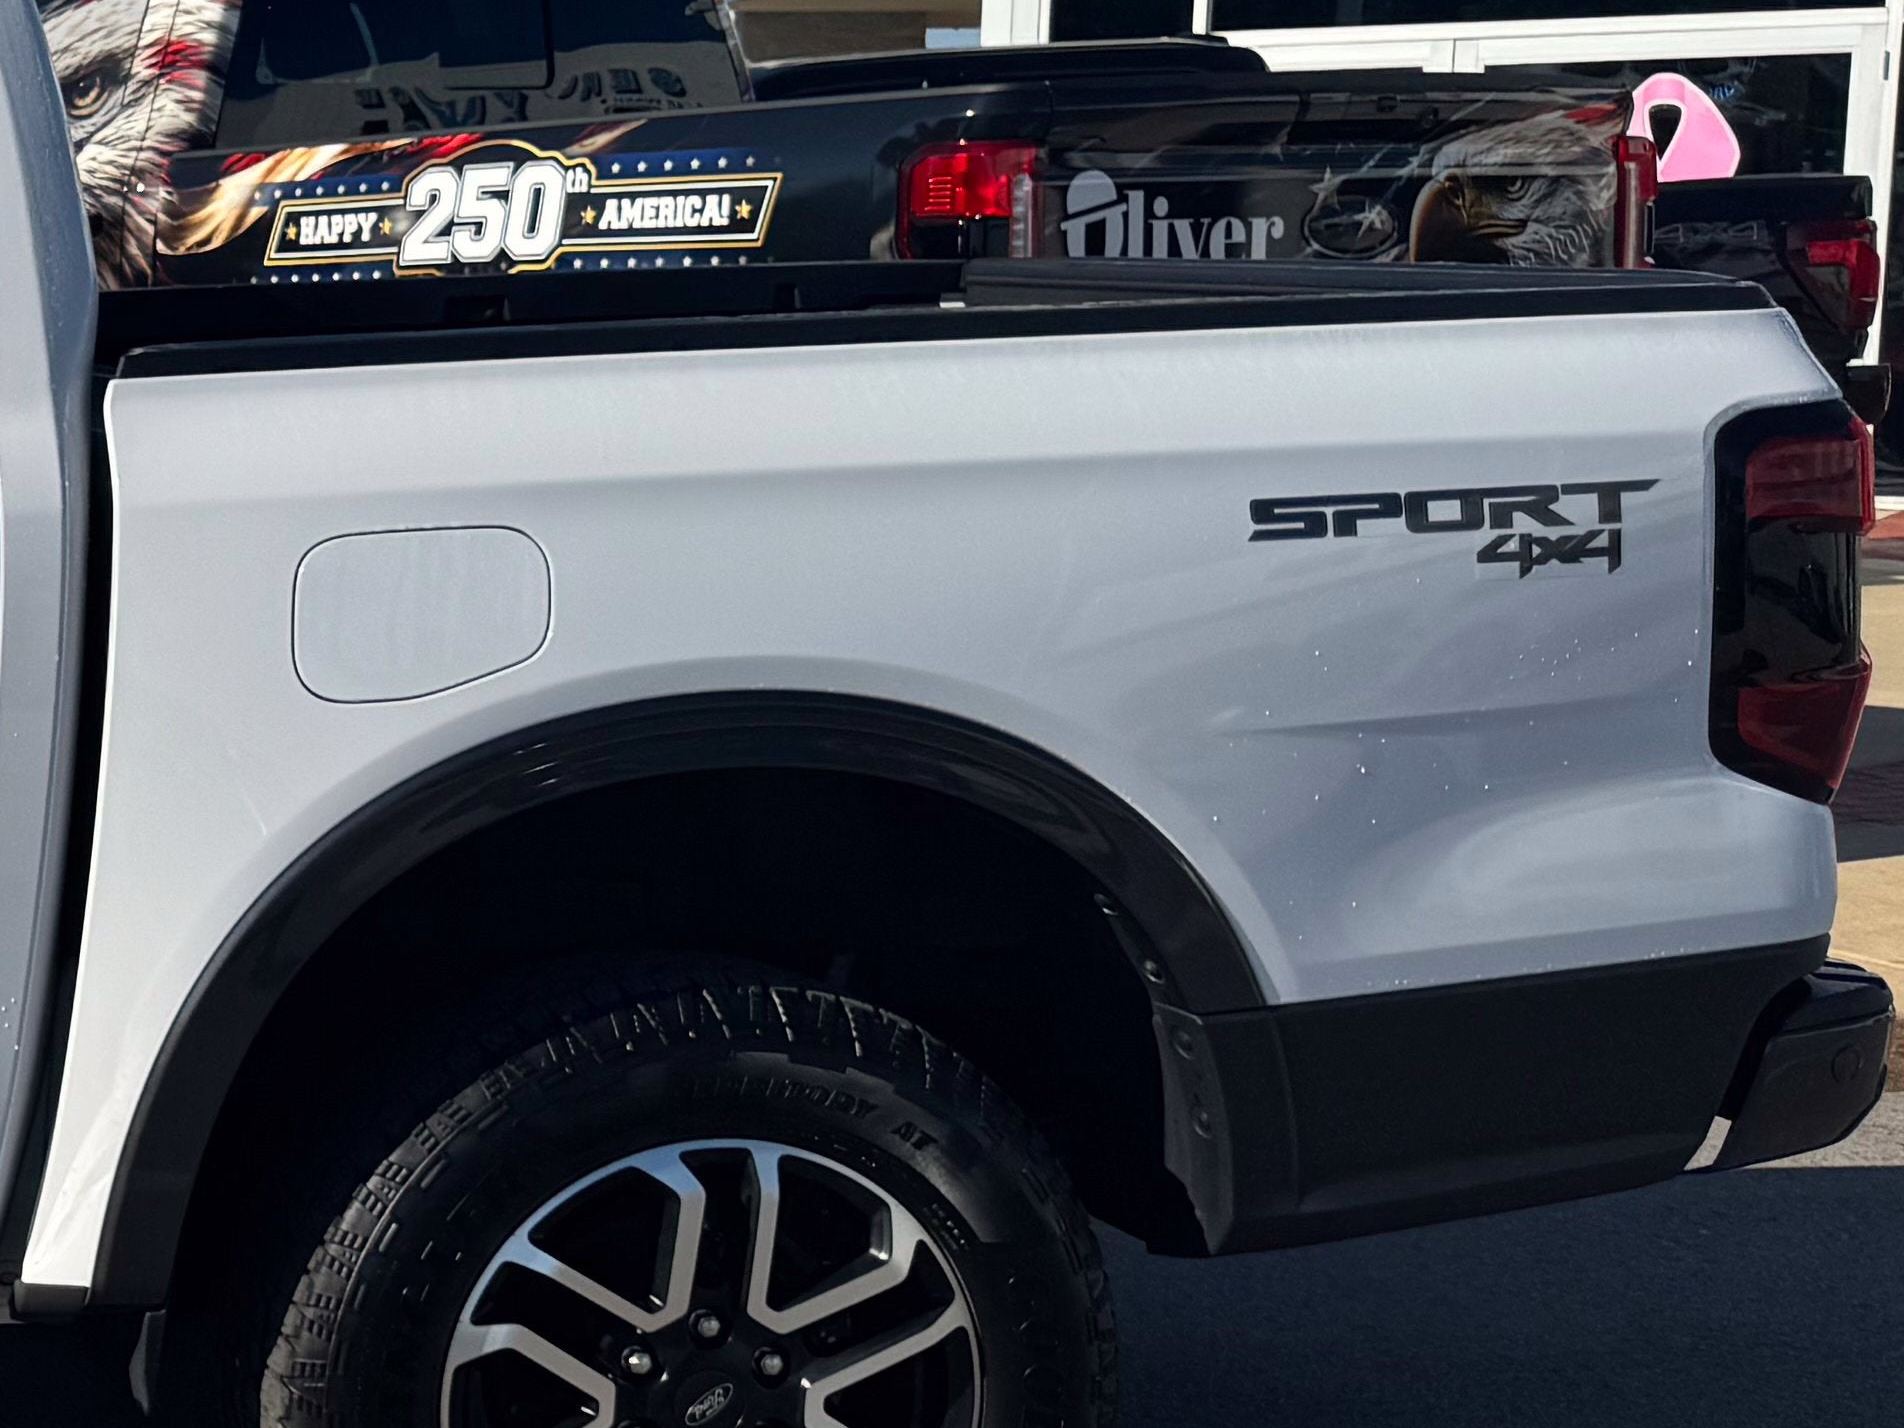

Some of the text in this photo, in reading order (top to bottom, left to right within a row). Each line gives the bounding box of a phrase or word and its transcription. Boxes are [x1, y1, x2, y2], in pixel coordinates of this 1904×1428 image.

[299, 212, 379, 246] HAPPY
[598, 194, 733, 231] AMERICA!
[1060, 169, 1284, 260] Oliver
[1248, 478, 1662, 542] SPORT
